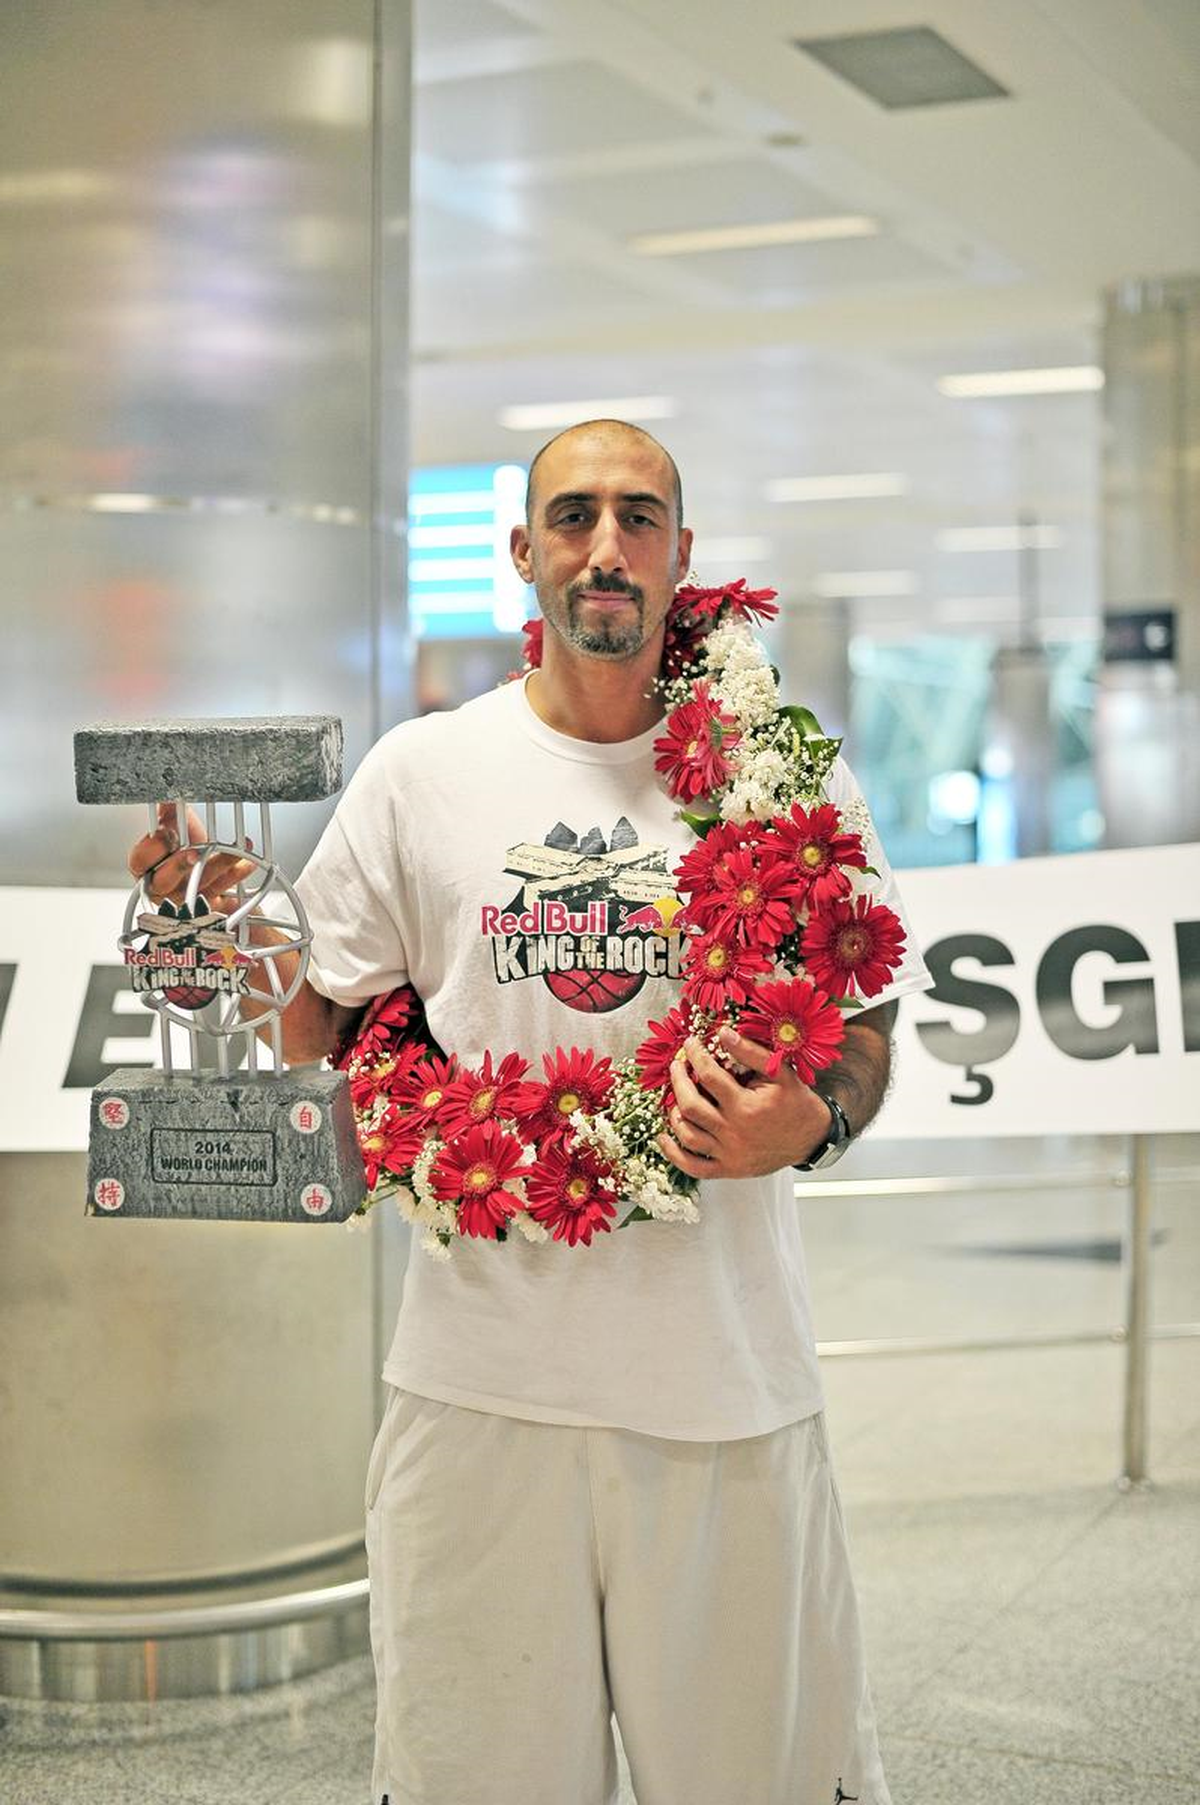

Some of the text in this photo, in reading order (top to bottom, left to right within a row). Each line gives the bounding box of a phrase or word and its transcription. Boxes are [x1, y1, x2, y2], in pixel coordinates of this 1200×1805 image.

[481, 901, 608, 935] Red Bull
[123, 947, 197, 967] Red Bull
[492, 934, 692, 983] KING OF THE ROCK
[195, 965, 250, 995] ROCK
[194, 1141, 232, 1155] 2014
[160, 1156, 268, 1173] WORLD CHAMPION
